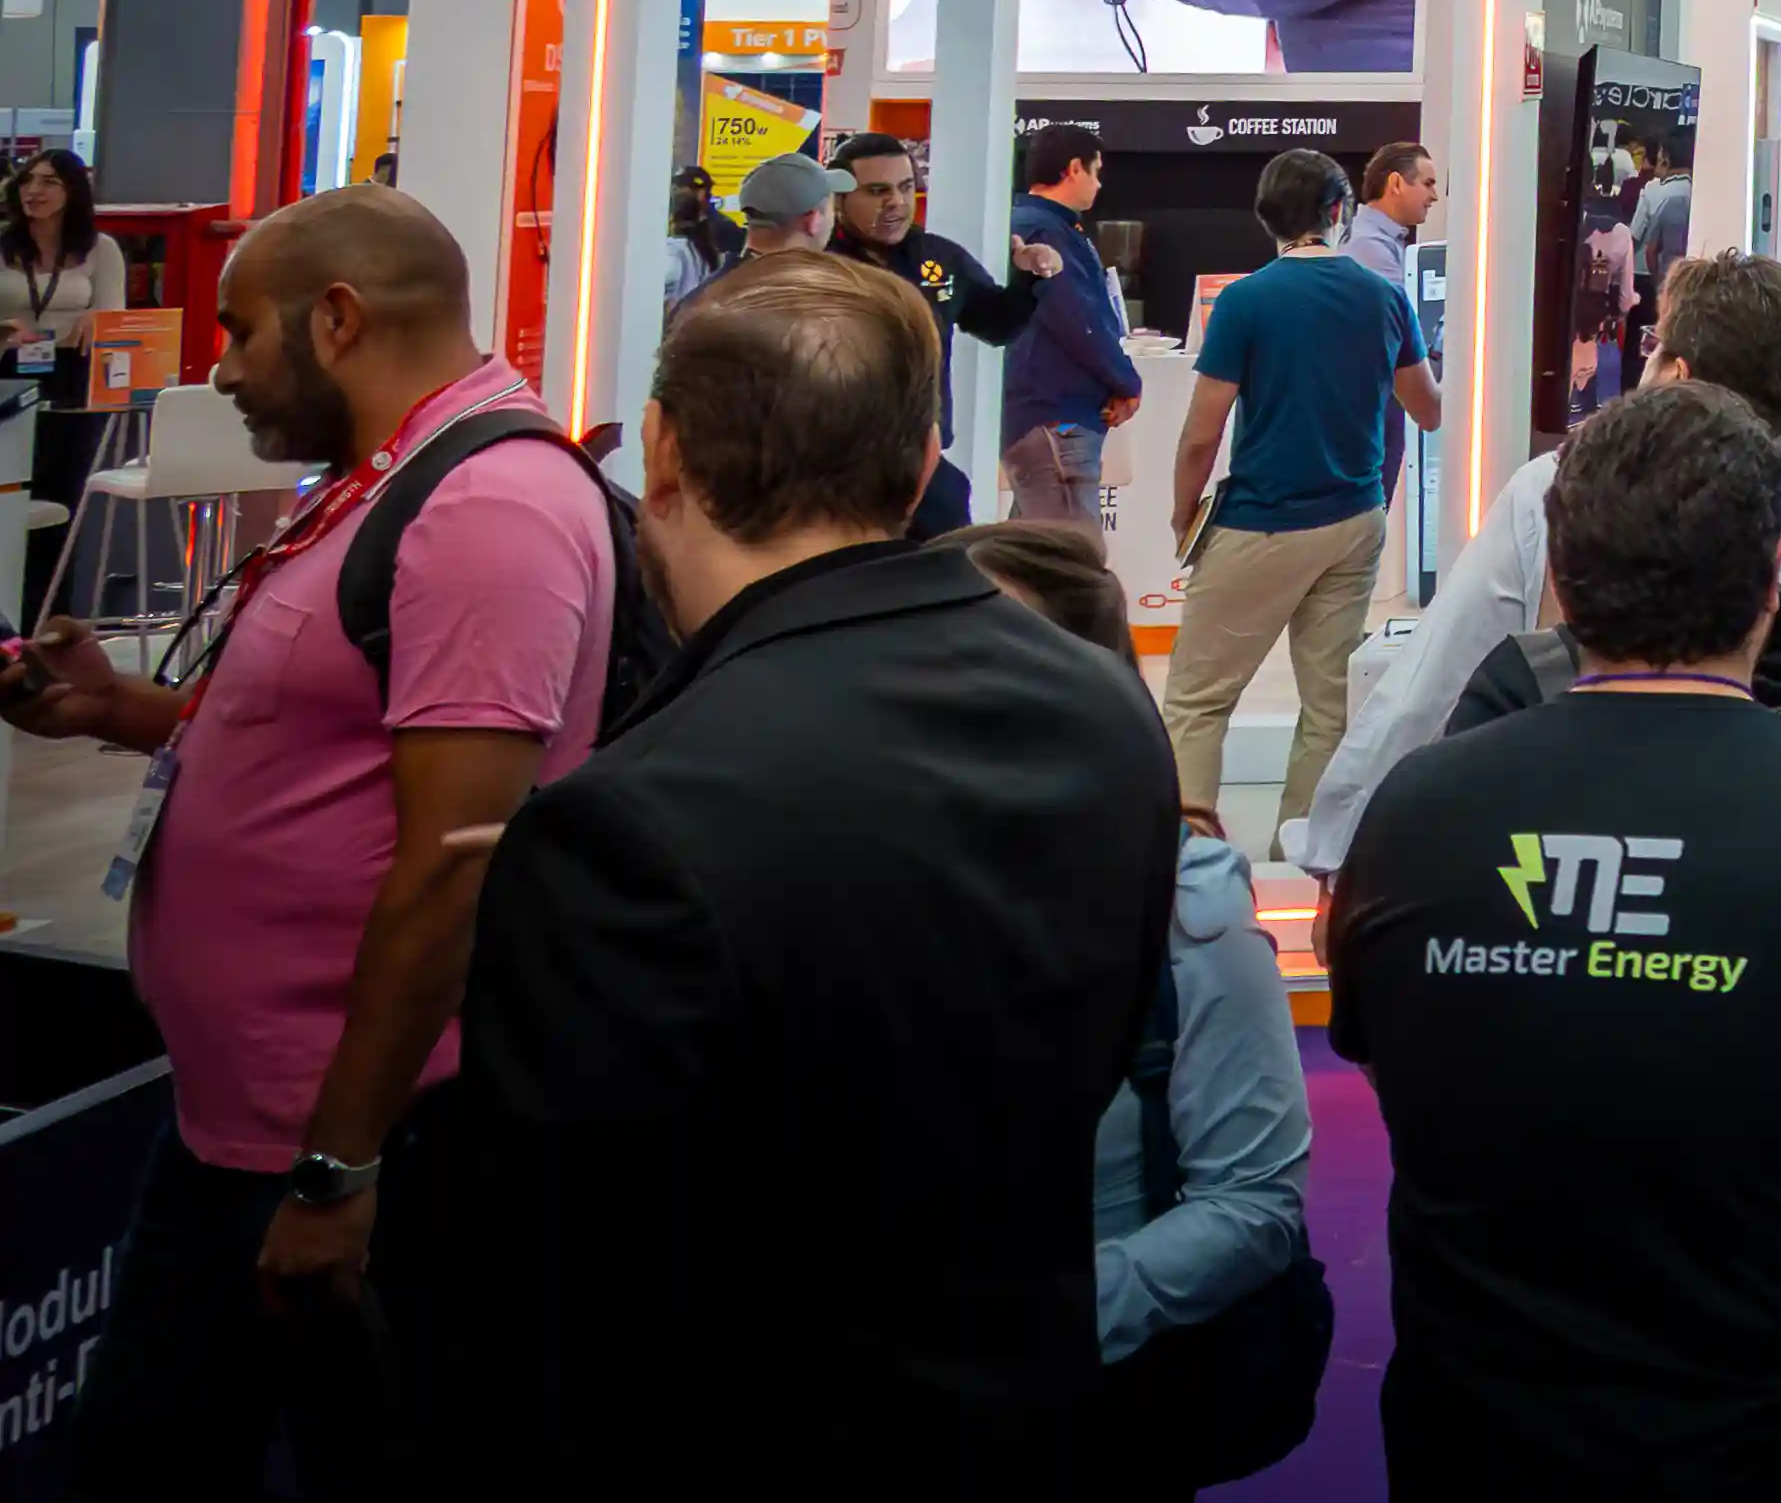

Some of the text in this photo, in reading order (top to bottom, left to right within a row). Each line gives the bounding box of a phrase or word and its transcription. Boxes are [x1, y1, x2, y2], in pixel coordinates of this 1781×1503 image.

[731, 27, 778, 47] Tier
[783, 28, 794, 47] 1
[1227, 117, 1337, 135] COFFEE STATION
[1424, 938, 1748, 993] Master Energy
